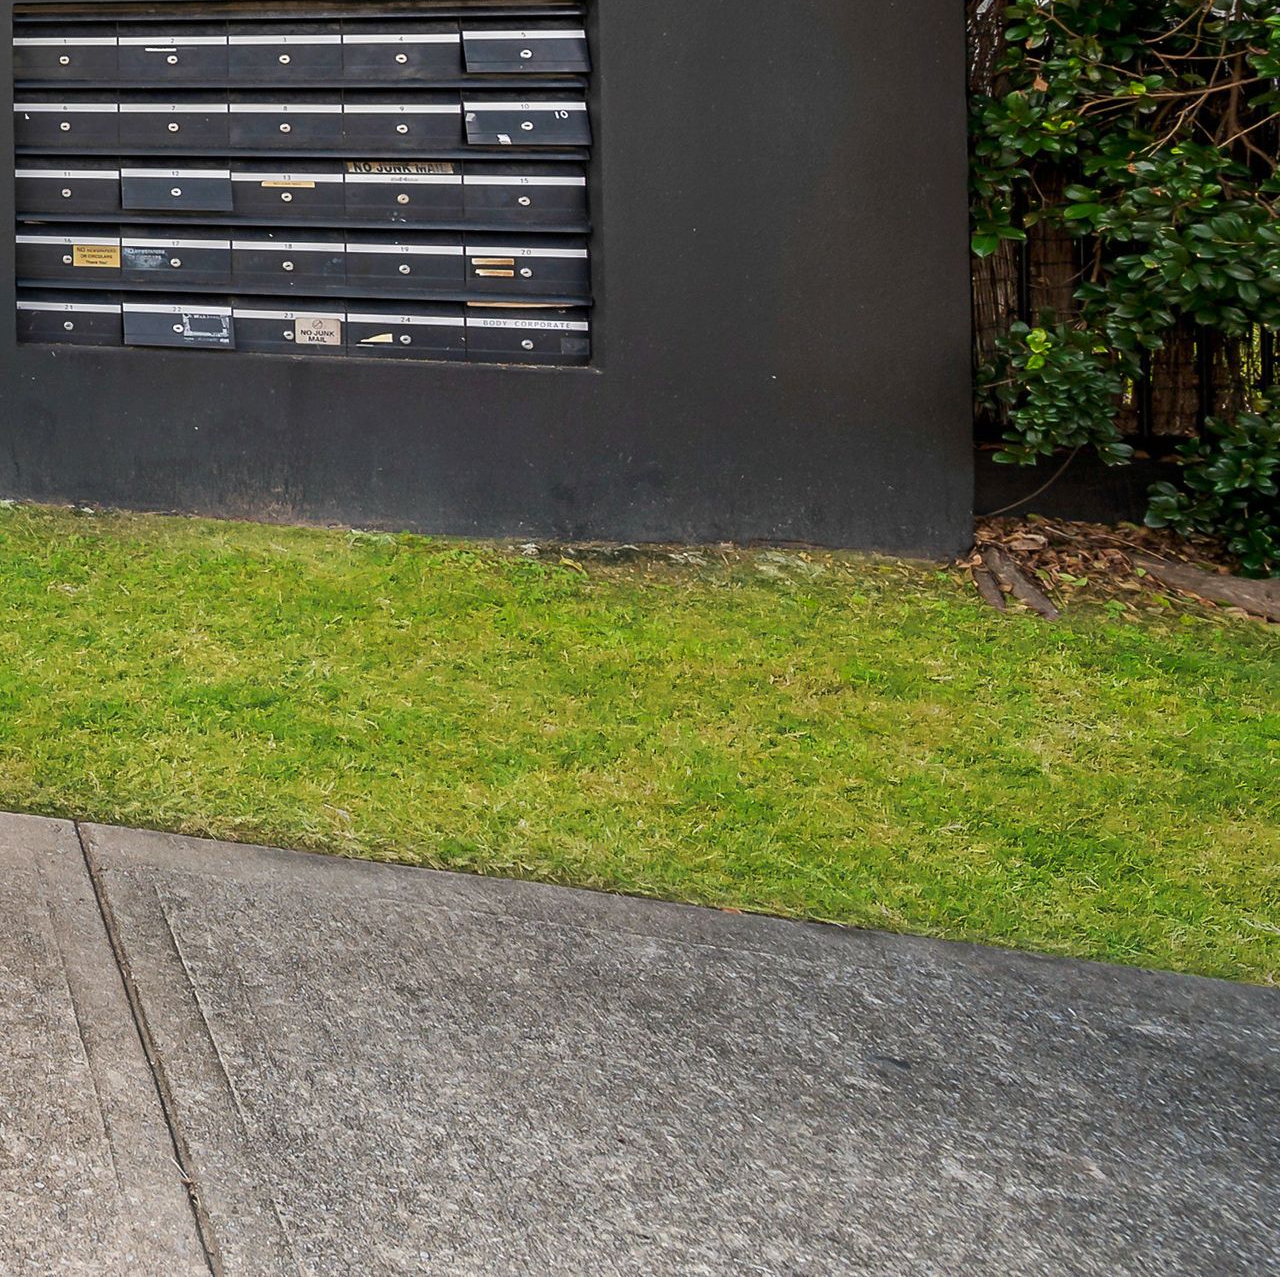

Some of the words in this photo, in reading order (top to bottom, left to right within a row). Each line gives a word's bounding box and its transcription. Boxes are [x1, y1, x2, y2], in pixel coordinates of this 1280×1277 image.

[554, 110, 569, 119] 10
[353, 162, 372, 173] NO
[376, 162, 412, 173] JUNK
[515, 321, 570, 329] CORPORATE
